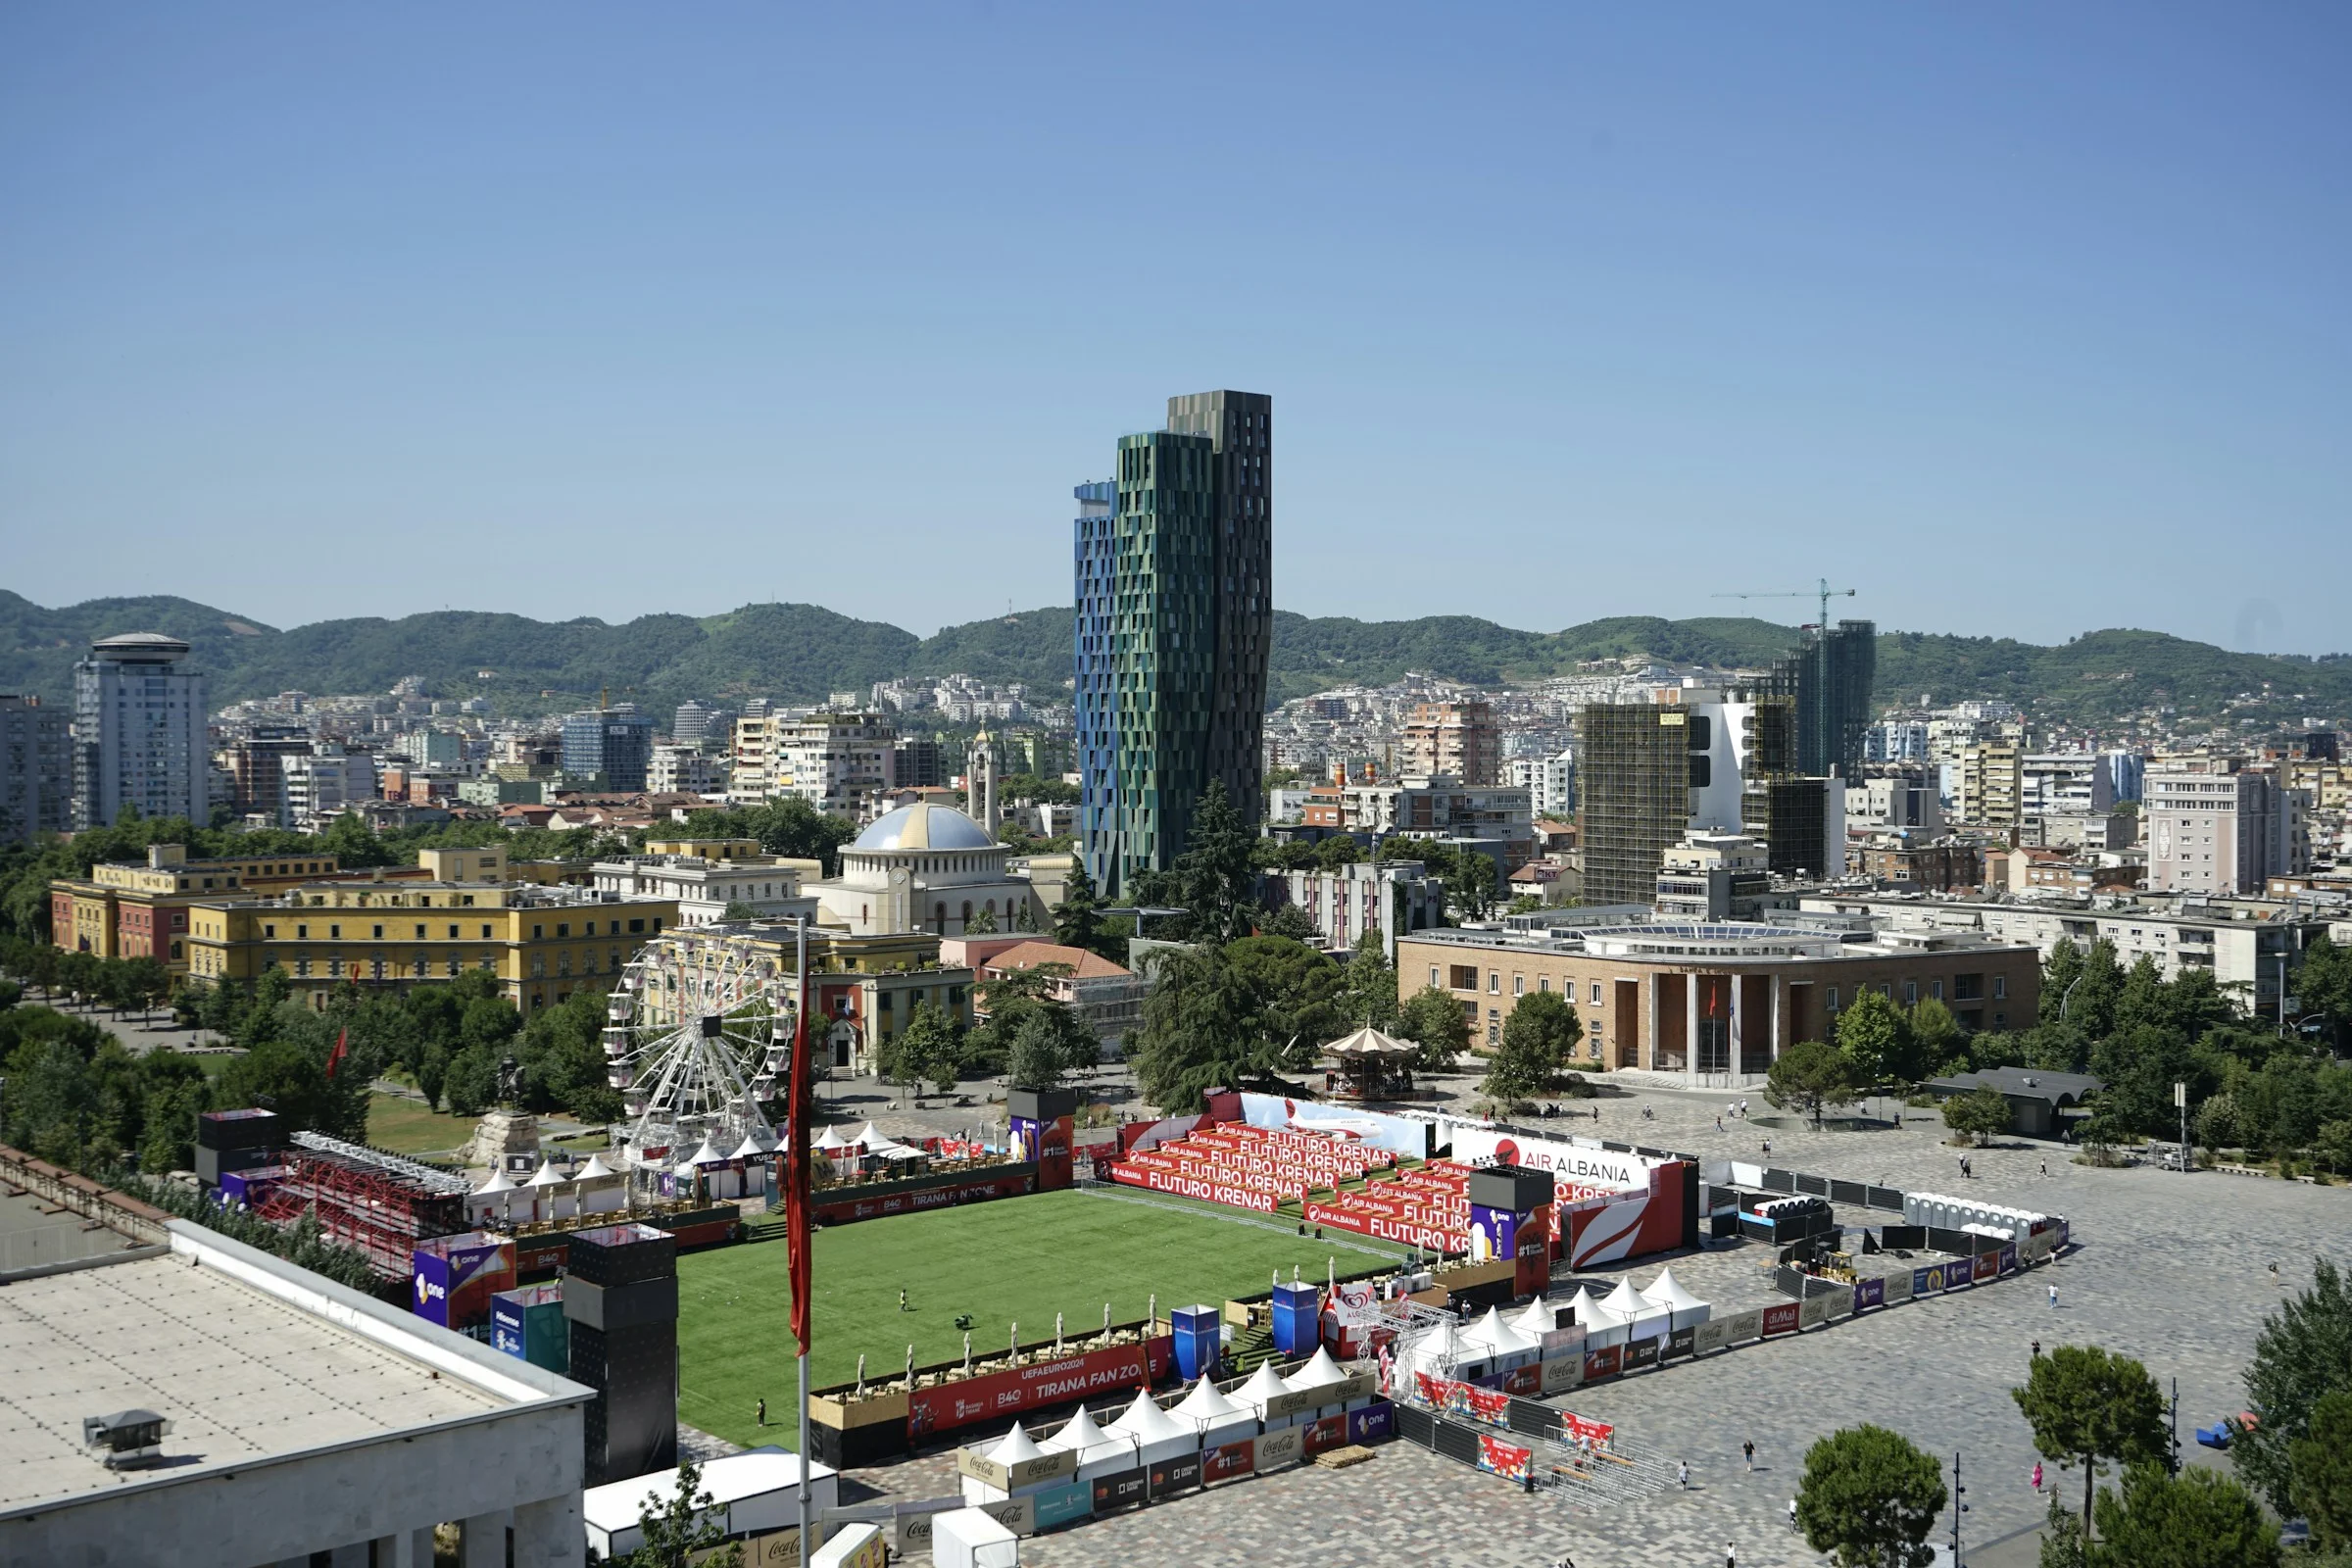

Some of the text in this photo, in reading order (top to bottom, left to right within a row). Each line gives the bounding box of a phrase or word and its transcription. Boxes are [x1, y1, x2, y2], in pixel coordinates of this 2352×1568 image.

[1267, 1131, 1392, 1165] FLUTURO KRENAR
[1149, 1158, 1173, 1169] ALBANIA
[1240, 1141, 1363, 1177] FLUTURO KRENAR
[1119, 1168, 1142, 1181] ALBANIA
[1210, 1151, 1334, 1188] FLUTURO KRENAR
[1525, 1152, 1631, 1184] AIR ALBANIA
[1180, 1160, 1303, 1199] FLUTURO KRENAR
[1412, 1176, 1423, 1185] AIR
[1424, 1179, 1453, 1191] ALBANIA
[912, 1193, 947, 1205] TIRANA
[949, 1190, 967, 1201] FN
[1149, 1171, 1272, 1211] FLUTURO KRENAR
[1395, 1190, 1424, 1201] ALBANIA
[1353, 1199, 1395, 1213] AIR ALBANIA
[1433, 1194, 1471, 1214] FLUT
[1320, 1211, 1360, 1227] AIR ALBANIA
[1497, 1213, 1509, 1222] one
[1370, 1218, 1446, 1249] FLUTURO
[461, 1254, 479, 1264] one
[1956, 1266, 1968, 1275] one
[426, 1282, 445, 1300] one
[1867, 1287, 1880, 1297] one
[495, 1310, 520, 1328] Hisense
[1768, 1308, 1795, 1324] diMal
[1593, 1358, 1604, 1369] #1
[1036, 1358, 1157, 1398] TIRANA FAN ZOE
[1514, 1377, 1524, 1389] #1
[1368, 1413, 1385, 1425] one
[1315, 1432, 1327, 1443] #1
[1217, 1457, 1231, 1469] #1
